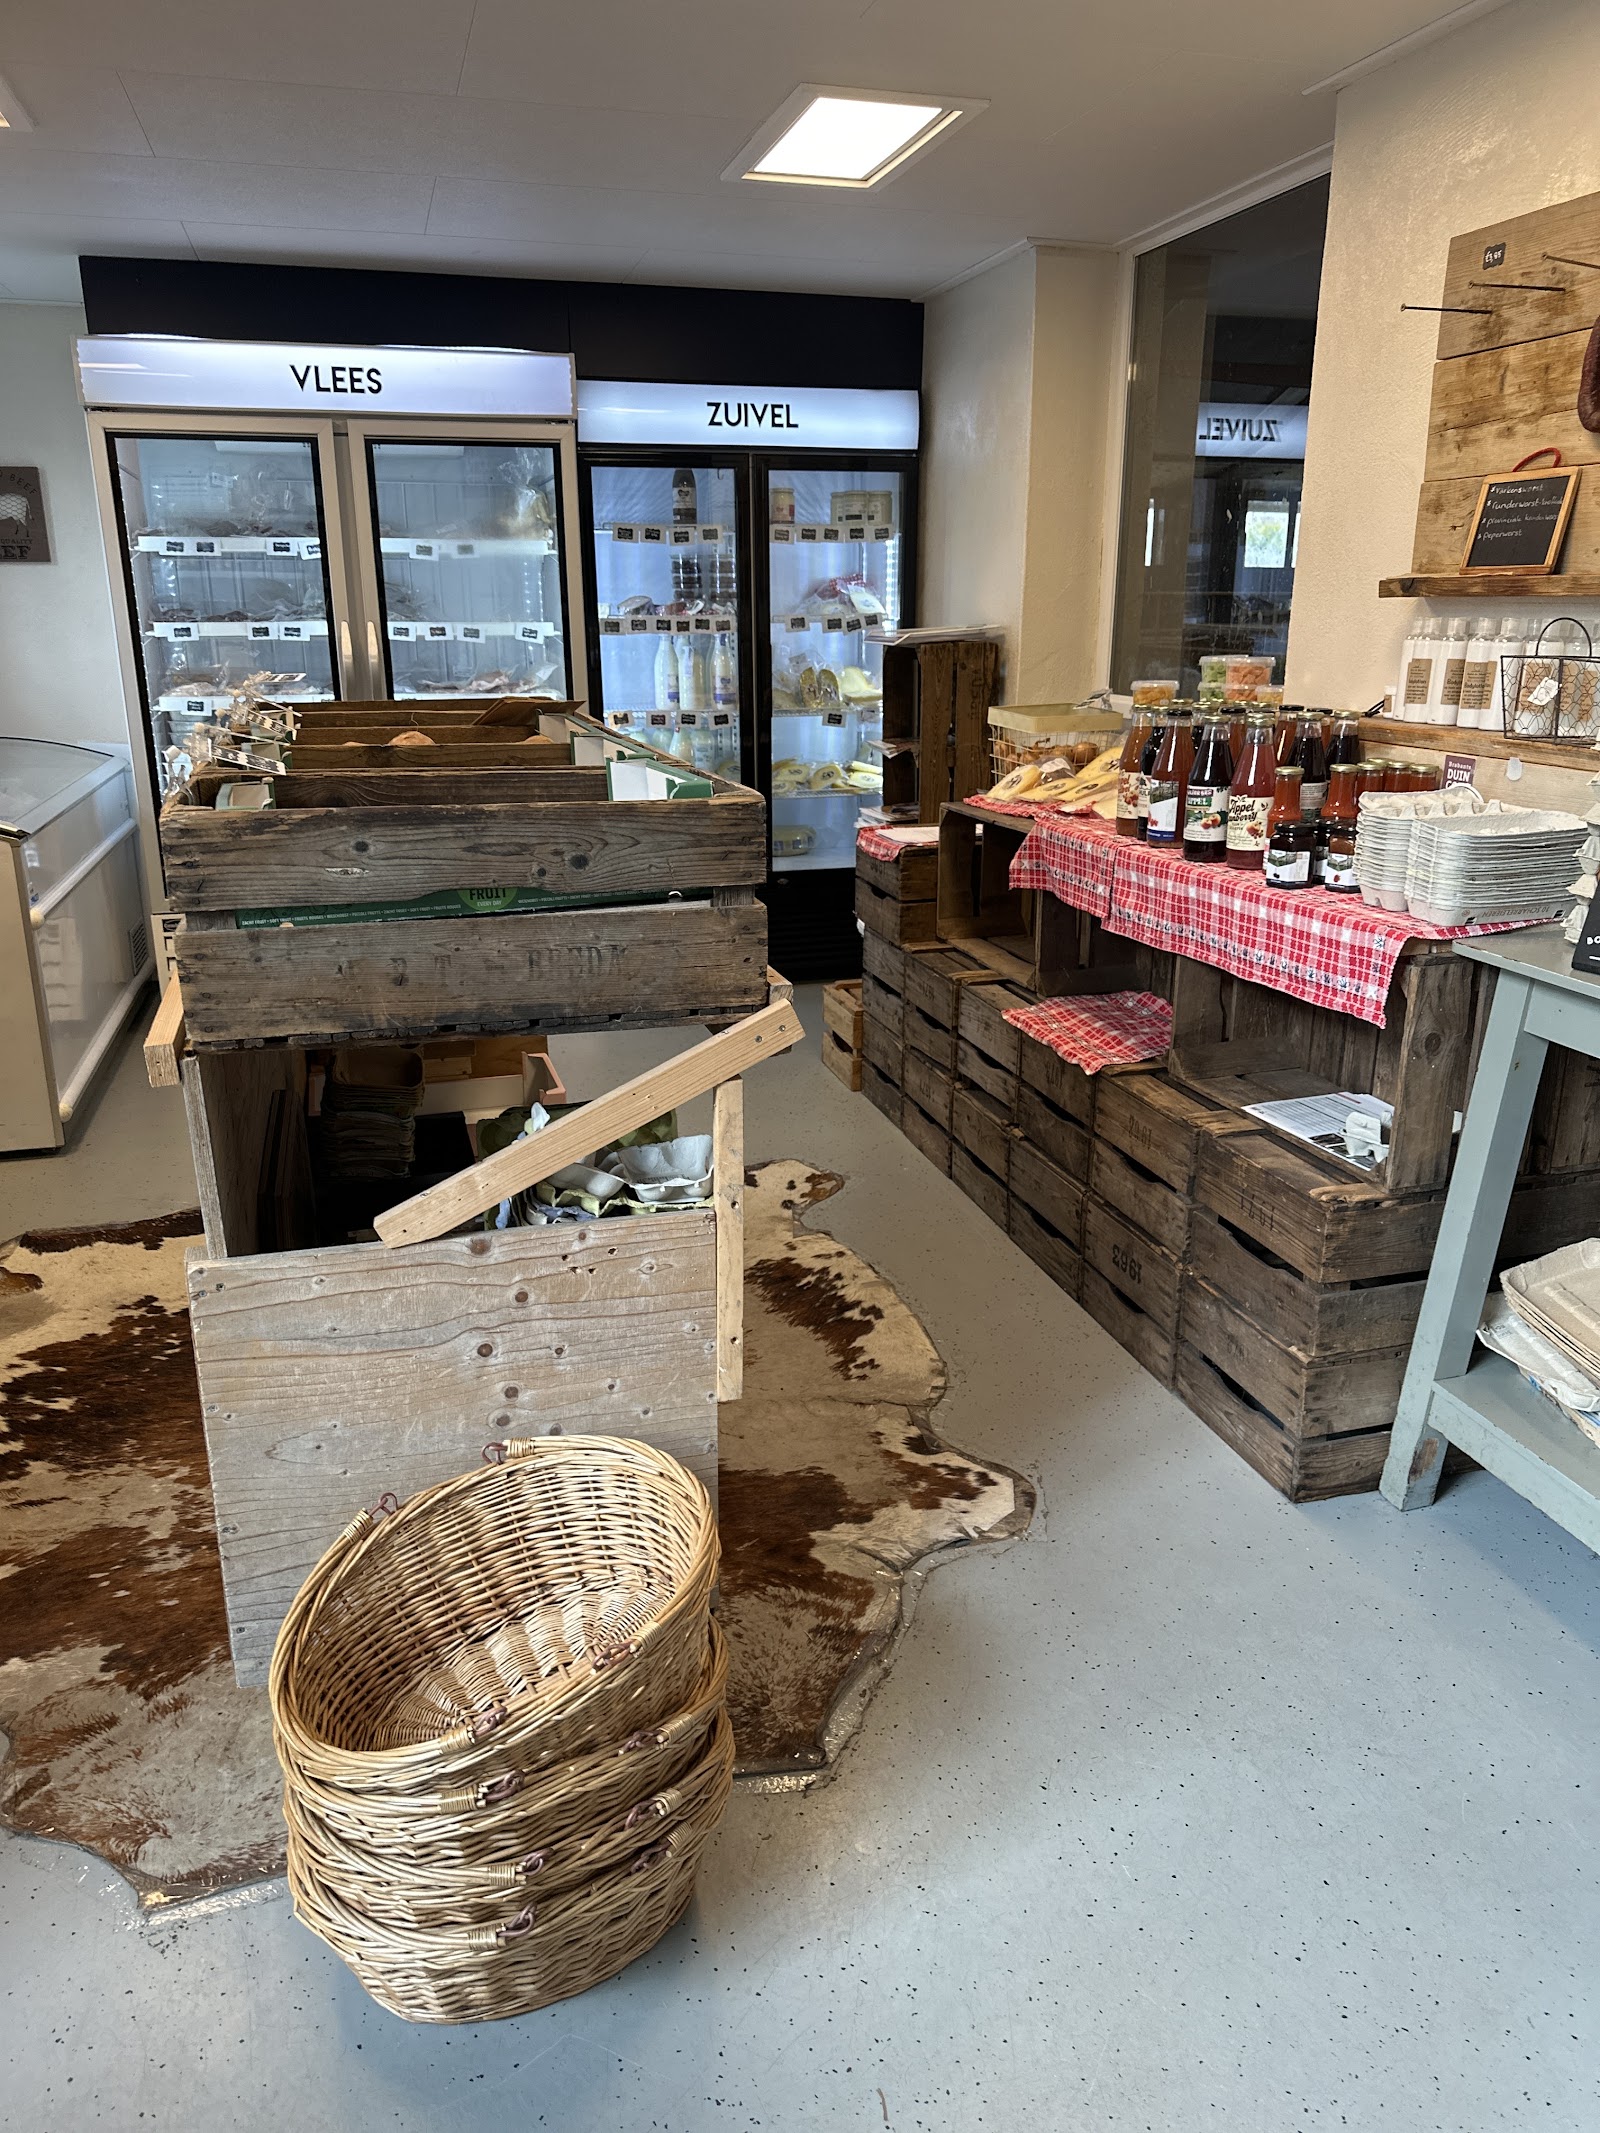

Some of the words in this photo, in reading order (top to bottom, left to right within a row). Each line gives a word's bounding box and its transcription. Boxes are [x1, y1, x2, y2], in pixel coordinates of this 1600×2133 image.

[289, 364, 383, 395] VLEES
[706, 402, 799, 428] ZUIVEL
[10, 473, 38, 495] BEEF
[0, 545, 31, 560] EF
[1447, 768, 1471, 782] DUIN
[1230, 799, 1256, 815] Appel
[469, 888, 507, 900] FRUIT
[1111, 1243, 1143, 1285] 1963
